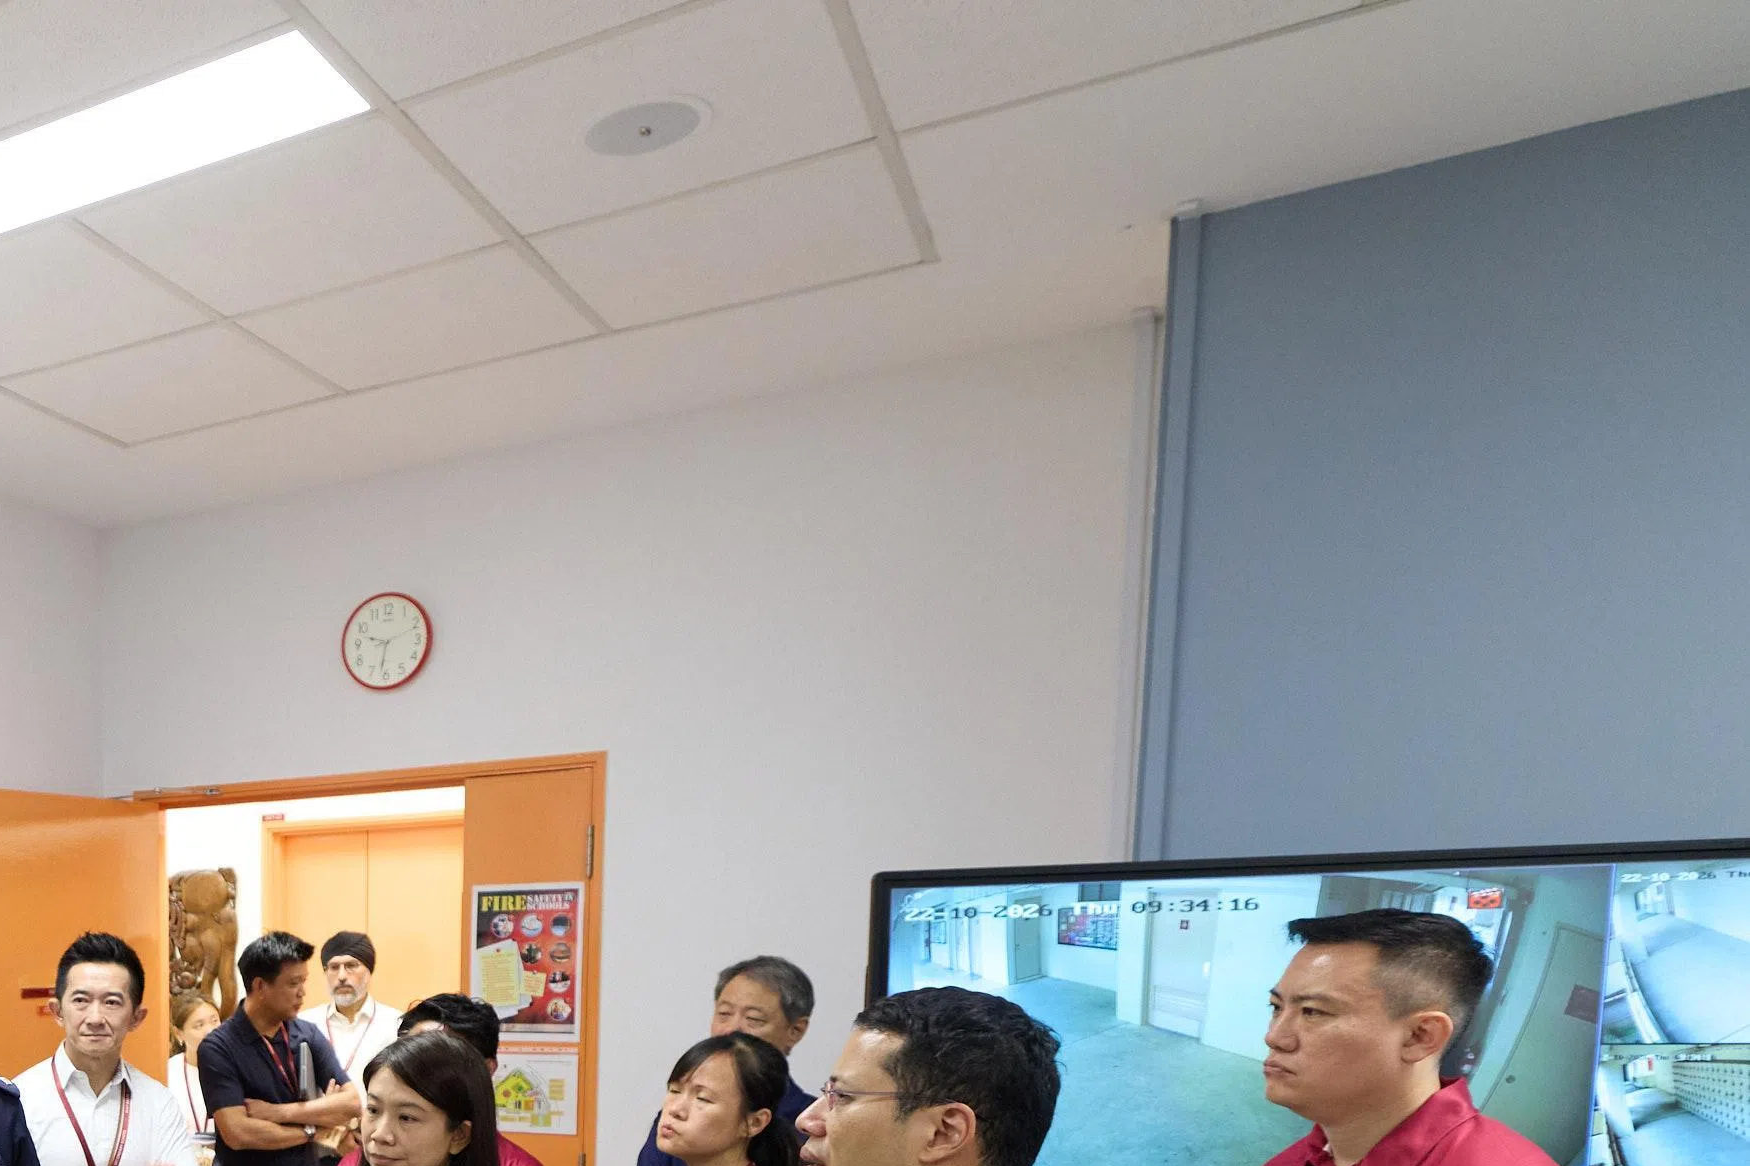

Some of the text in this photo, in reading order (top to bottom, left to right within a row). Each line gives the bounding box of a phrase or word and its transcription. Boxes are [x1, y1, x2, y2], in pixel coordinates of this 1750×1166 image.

[359, 622, 368, 633] 10
[355, 639, 361, 649] 9
[481, 895, 527, 911] FIRE
[905, 898, 1260, 921] 22-10-2026 Thu 09:34:16
